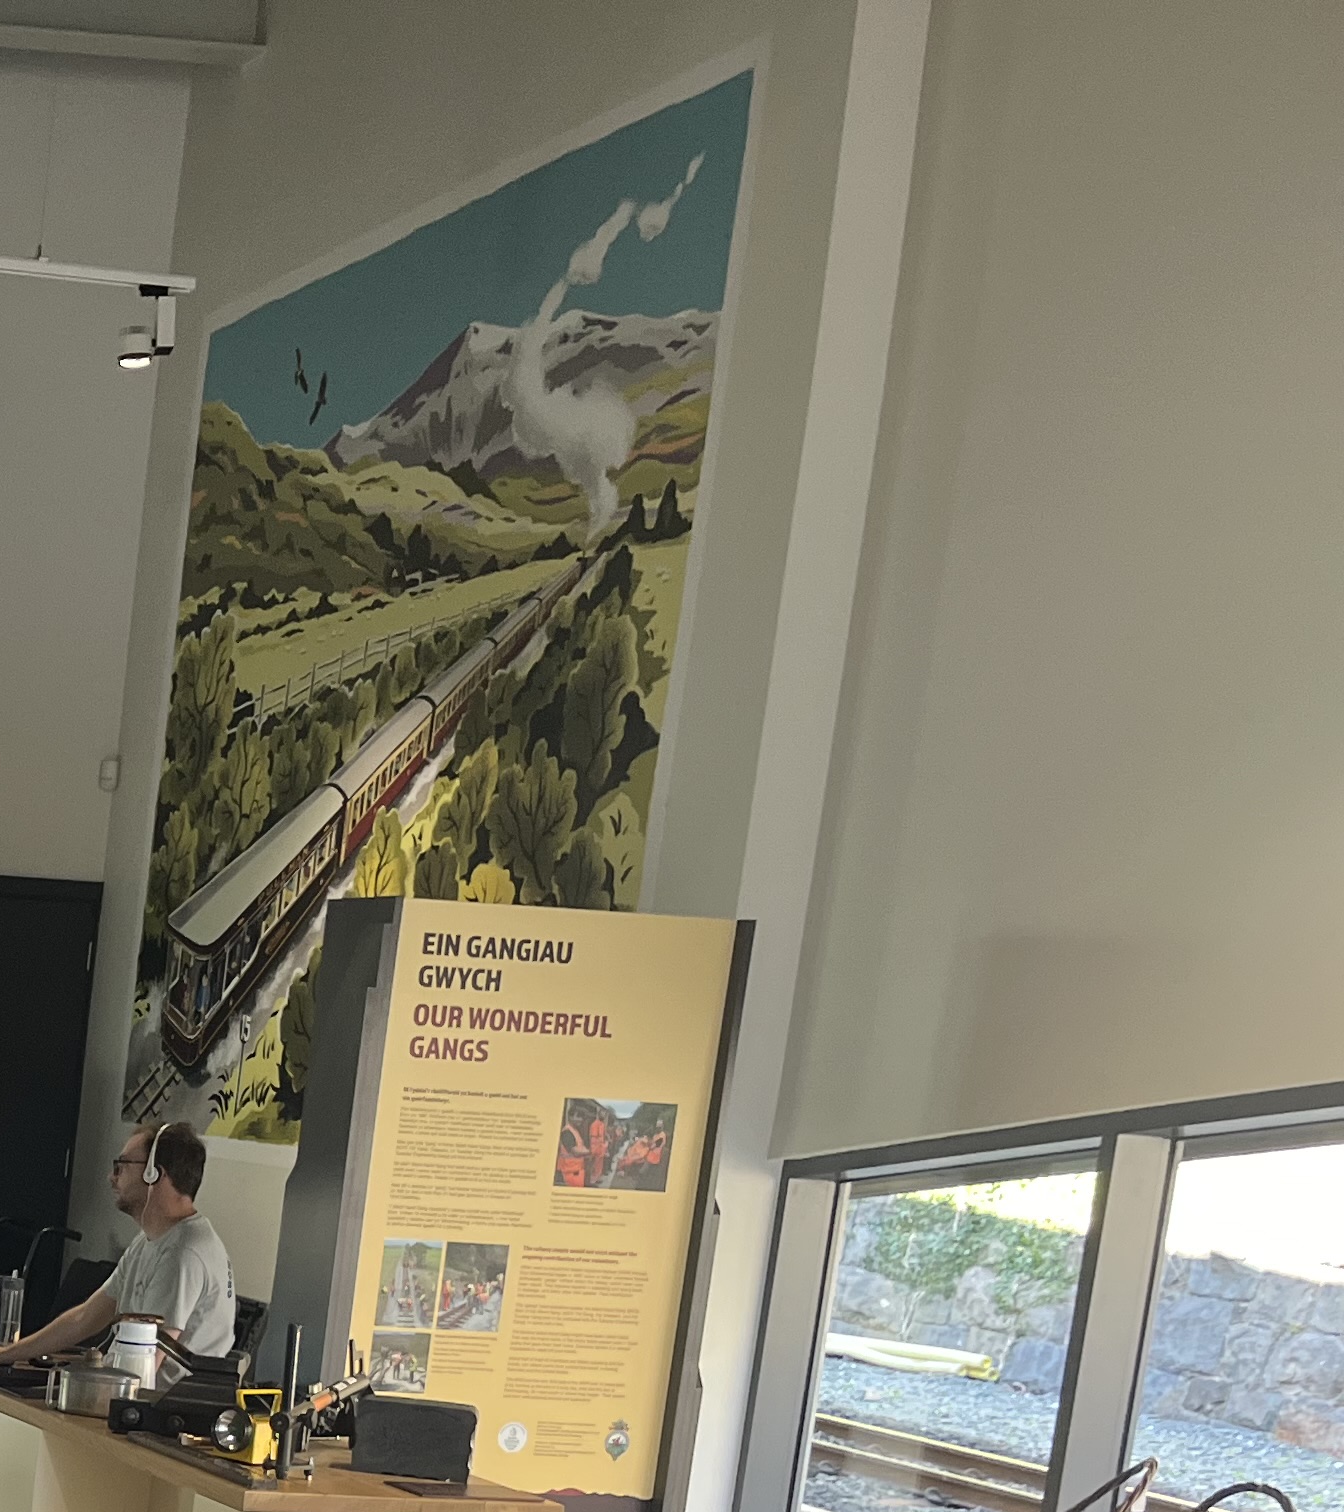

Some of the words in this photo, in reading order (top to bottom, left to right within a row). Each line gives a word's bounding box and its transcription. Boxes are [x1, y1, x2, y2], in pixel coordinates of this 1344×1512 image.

[422, 932, 462, 957] EIN
[466, 935, 574, 964] GANGIAU
[418, 965, 503, 992] GWYCH
[413, 1003, 463, 1029] OUR
[468, 1006, 612, 1039] WONDERFUL
[409, 1036, 490, 1062] GANGS
